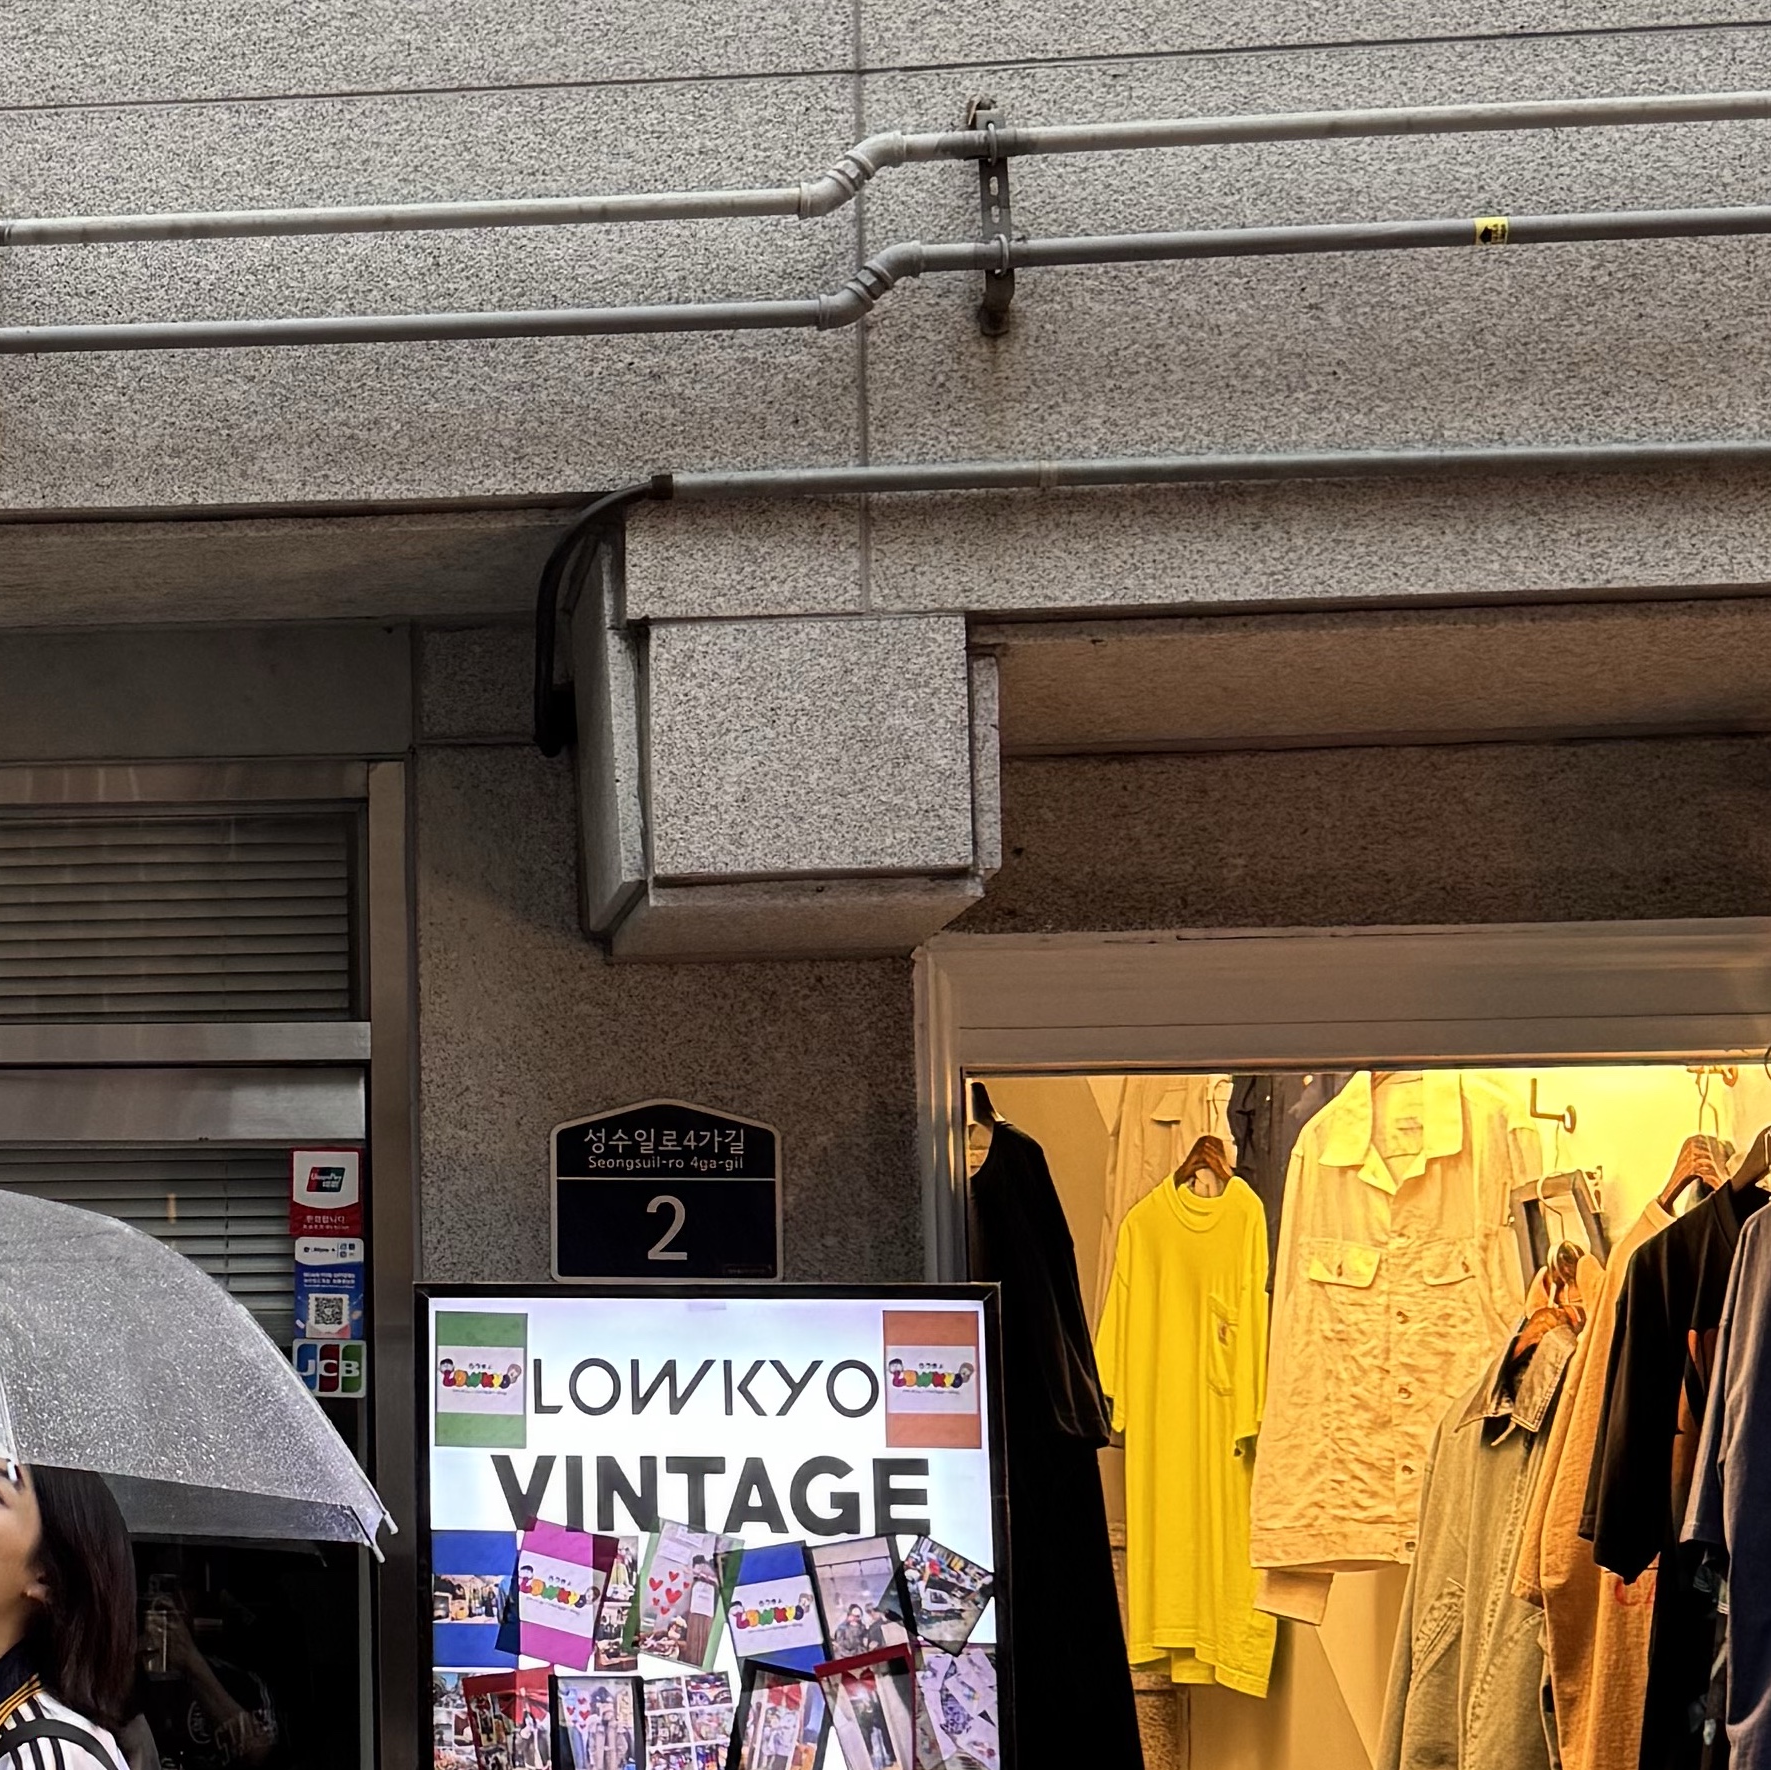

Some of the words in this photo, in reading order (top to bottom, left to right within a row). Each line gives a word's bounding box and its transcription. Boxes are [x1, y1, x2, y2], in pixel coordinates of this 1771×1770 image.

[583, 1128, 745, 1155] 성수일로4가길
[588, 1155, 684, 1171] Seongsuil-ro
[690, 1156, 744, 1172] 4ga-gil
[646, 1194, 688, 1261] 2
[298, 1358, 361, 1377] JCB
[533, 1357, 880, 1418] LOWKYO
[490, 1453, 931, 1537] VINTAGE
